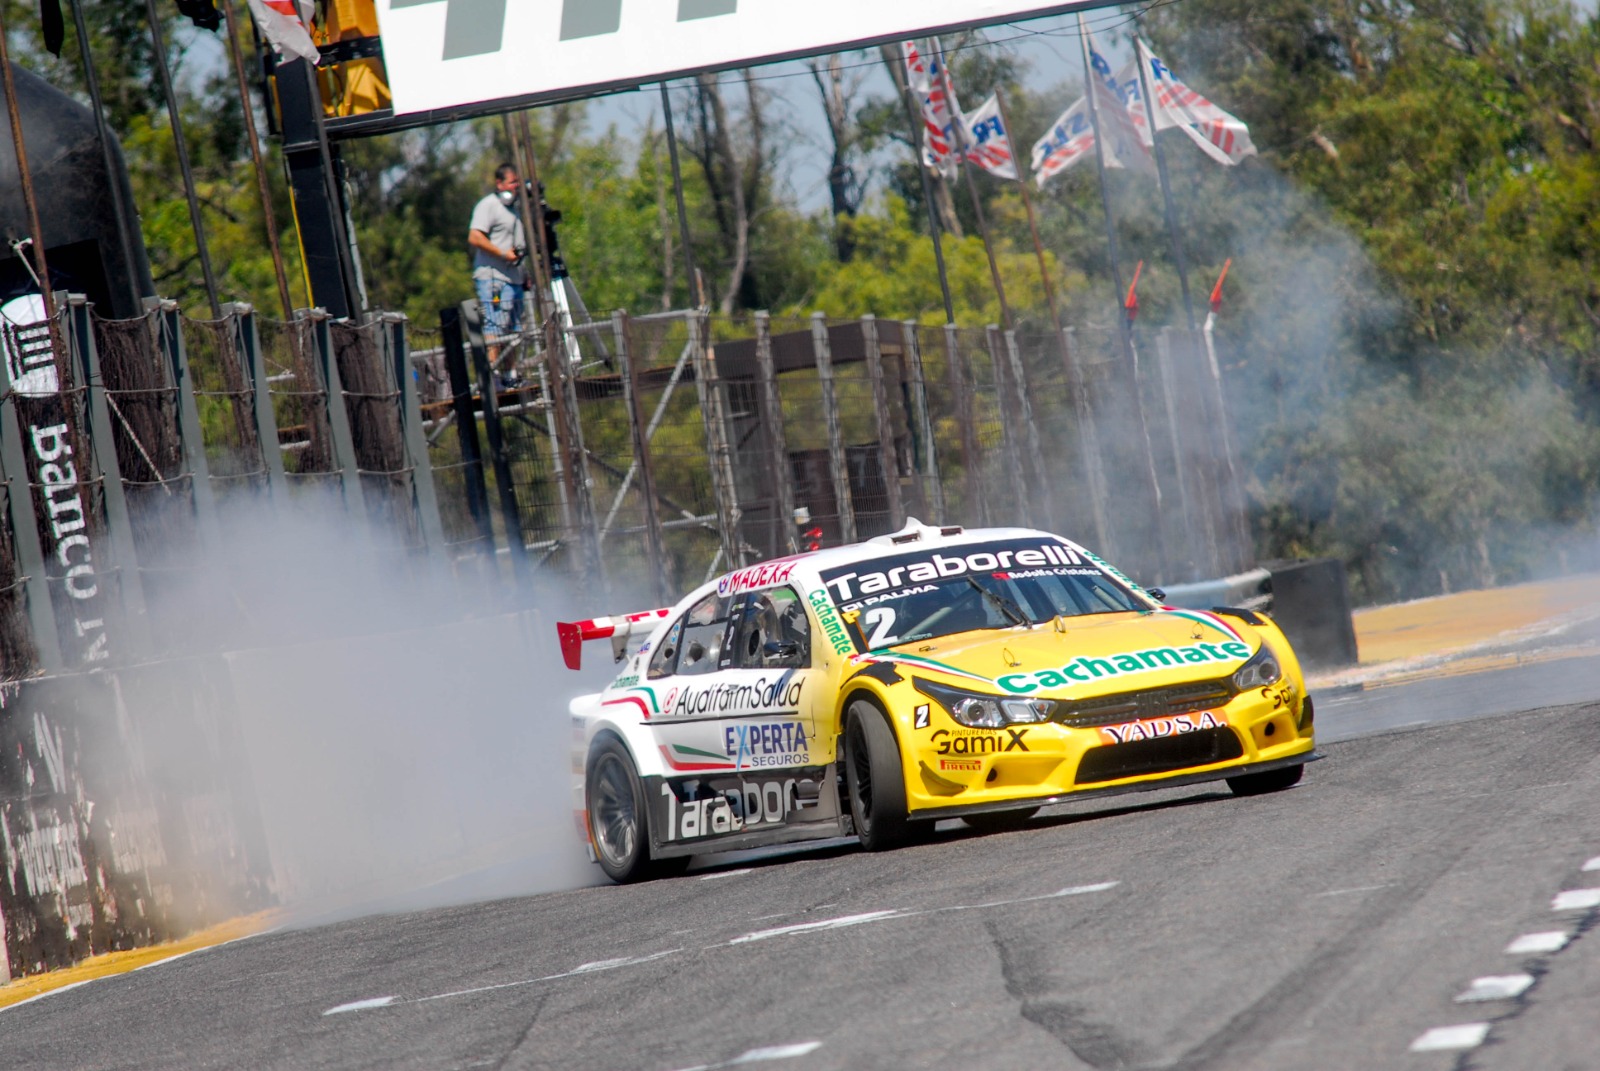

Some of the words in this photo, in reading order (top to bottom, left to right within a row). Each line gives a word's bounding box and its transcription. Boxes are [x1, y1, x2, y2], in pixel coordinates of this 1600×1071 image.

[826, 545, 1083, 601] Taraborelli
[1008, 568, 1053, 579] Rodolfo
[841, 600, 864, 613] DI
[864, 584, 940, 606] PALMA
[808, 589, 851, 656] Cachamate
[865, 607, 898, 650] 2
[997, 641, 1250, 693] Cachamate
[915, 704, 929, 729] 2
[725, 722, 808, 760] EXPERTA
[752, 753, 810, 768] SEGUROS
[940, 760, 982, 771] PIRELLI
